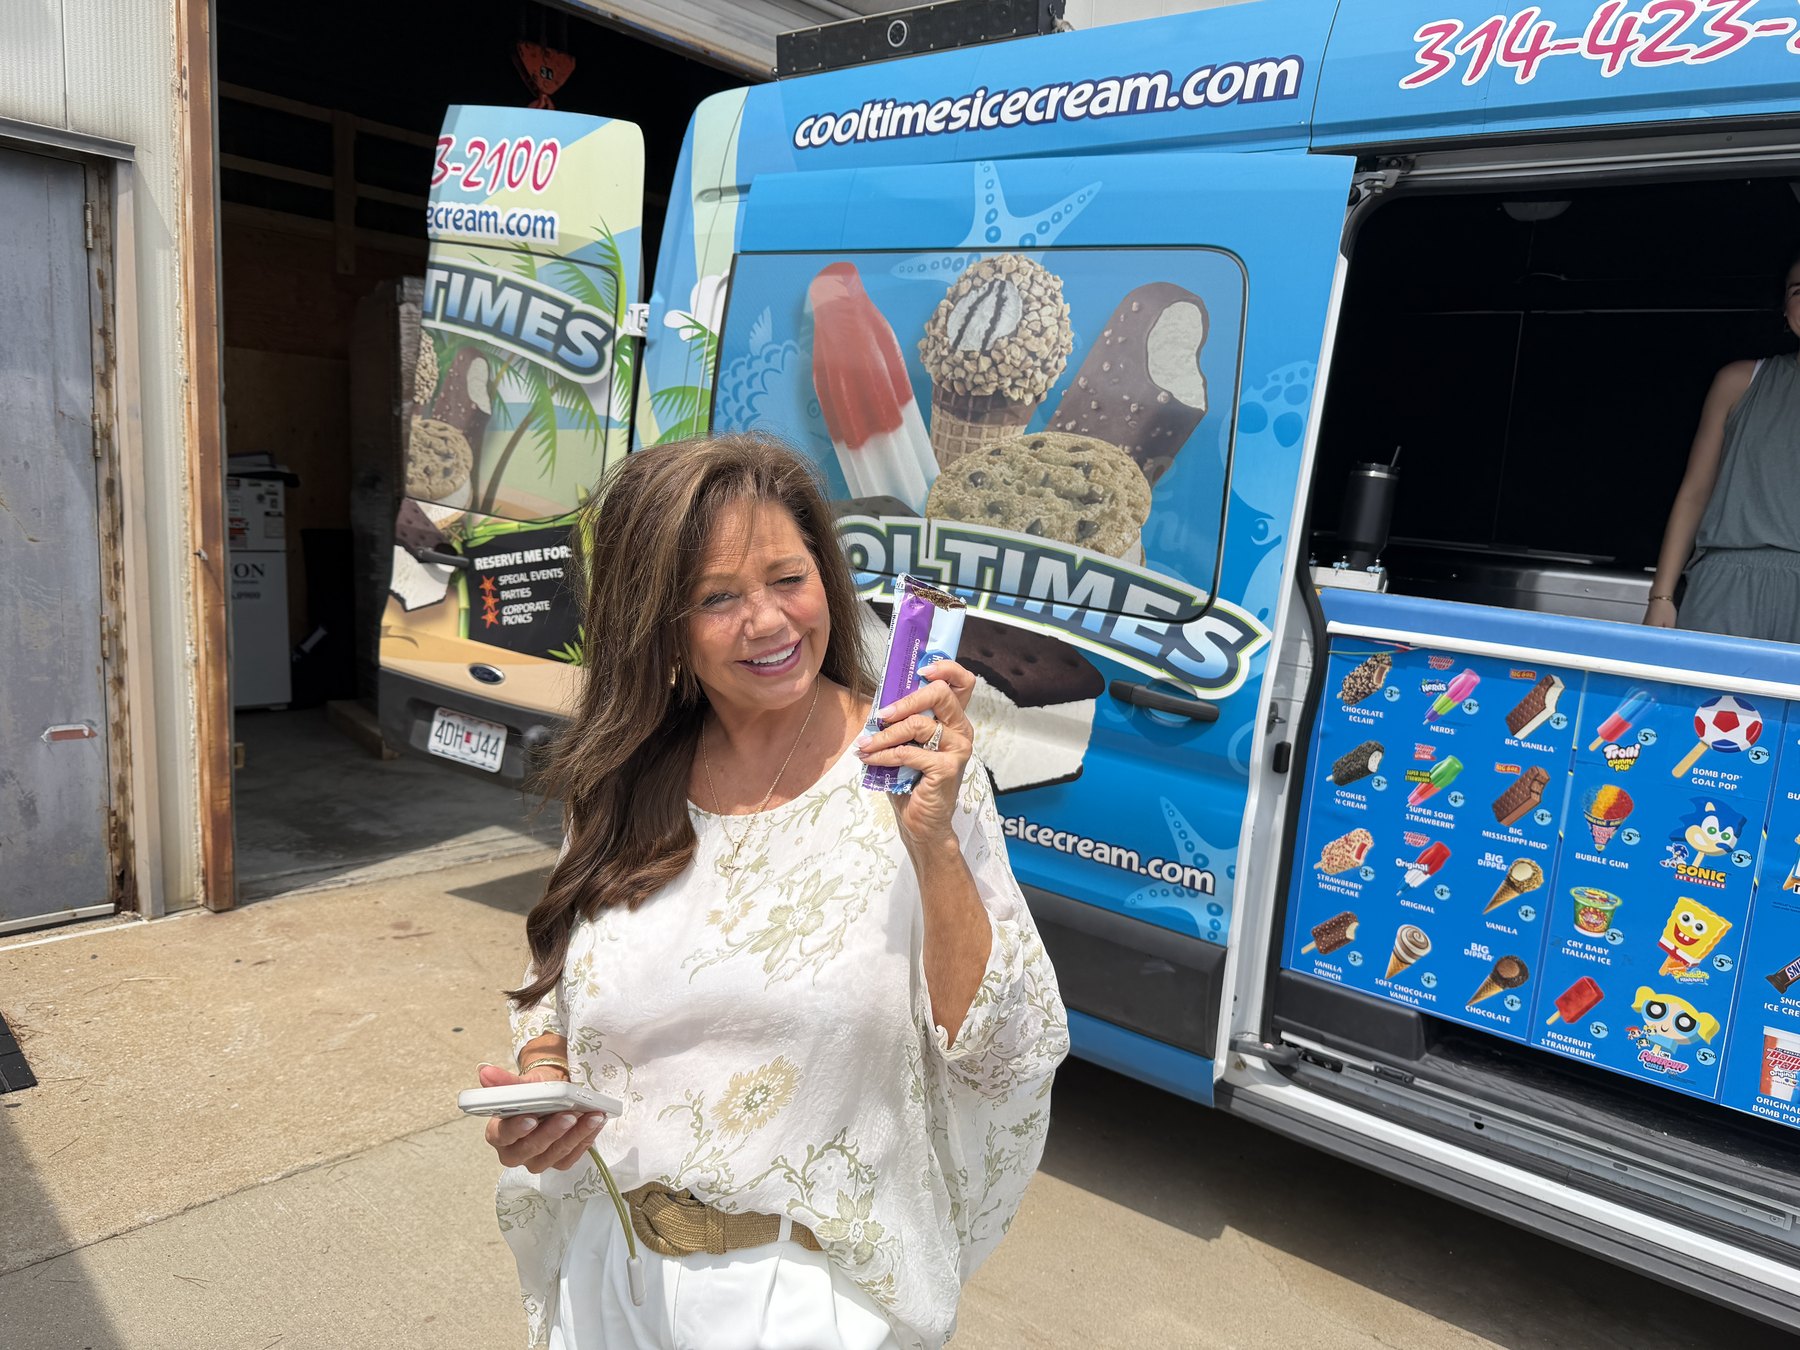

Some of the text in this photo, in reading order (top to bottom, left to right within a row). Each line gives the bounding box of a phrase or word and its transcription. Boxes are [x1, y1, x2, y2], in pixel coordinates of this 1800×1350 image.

[1399, 0, 1800, 89] 314-423-
[793, 54, 1304, 150] cooltimesicecream.com
[431, 136, 561, 195] 3-2100
[474, 545, 572, 571] RESERVE ME FOR:
[232, 563, 265, 578] ON
[498, 568, 564, 586] SPECIAL EVENTS
[500, 587, 532, 600] PARTIES
[502, 600, 550, 616] CORPORATE
[1341, 705, 1384, 719] CHOCOLATE
[1348, 715, 1374, 725] ECLAIR
[1430, 725, 1455, 735] NERDS
[1505, 738, 1554, 753] BIG VANILLA
[1603, 743, 1641, 759] Trolli
[1692, 767, 1740, 780] BOMB POP
[1691, 777, 1738, 791] GOAL POP
[1335, 789, 1367, 801] COOKIES
[1342, 798, 1367, 810] CREAM
[1409, 805, 1454, 821] SUPER SOUR
[1405, 813, 1455, 830] STRAWBERRY
[1508, 827, 1523, 836] BIG
[1482, 830, 1548, 850] MISSISSIPPI MUD
[1477, 859, 1508, 871] DIPPER
[1484, 852, 1504, 864] BIG
[1575, 852, 1629, 870] BUBBLE GUM
[1677, 863, 1727, 883] SONIC
[1316, 873, 1363, 891] STRAWBERRY
[1318, 882, 1359, 898] SHORTCAKE
[1400, 899, 1435, 914] ORIGINAL
[1485, 921, 1518, 935] VANILLA
[1470, 942, 1490, 955] BIG
[1566, 939, 1609, 955] CRY BABY
[1463, 948, 1494, 962] DIPPER
[1561, 947, 1612, 966] ITALIAN ICE
[1314, 959, 1343, 973] VANILLA
[1313, 967, 1342, 981] CRUNCH
[1374, 977, 1437, 1002] SOFT CHOCOLATE
[1389, 990, 1419, 1005] VANILLA
[1465, 1005, 1511, 1024] CHOCOLATE
[1764, 1003, 1779, 1012] ICE
[1547, 1031, 1593, 1050] FROZFRUIT
[1540, 1038, 1596, 1060] STRAWBERRY
[1752, 1104, 1780, 1119] BOMB
